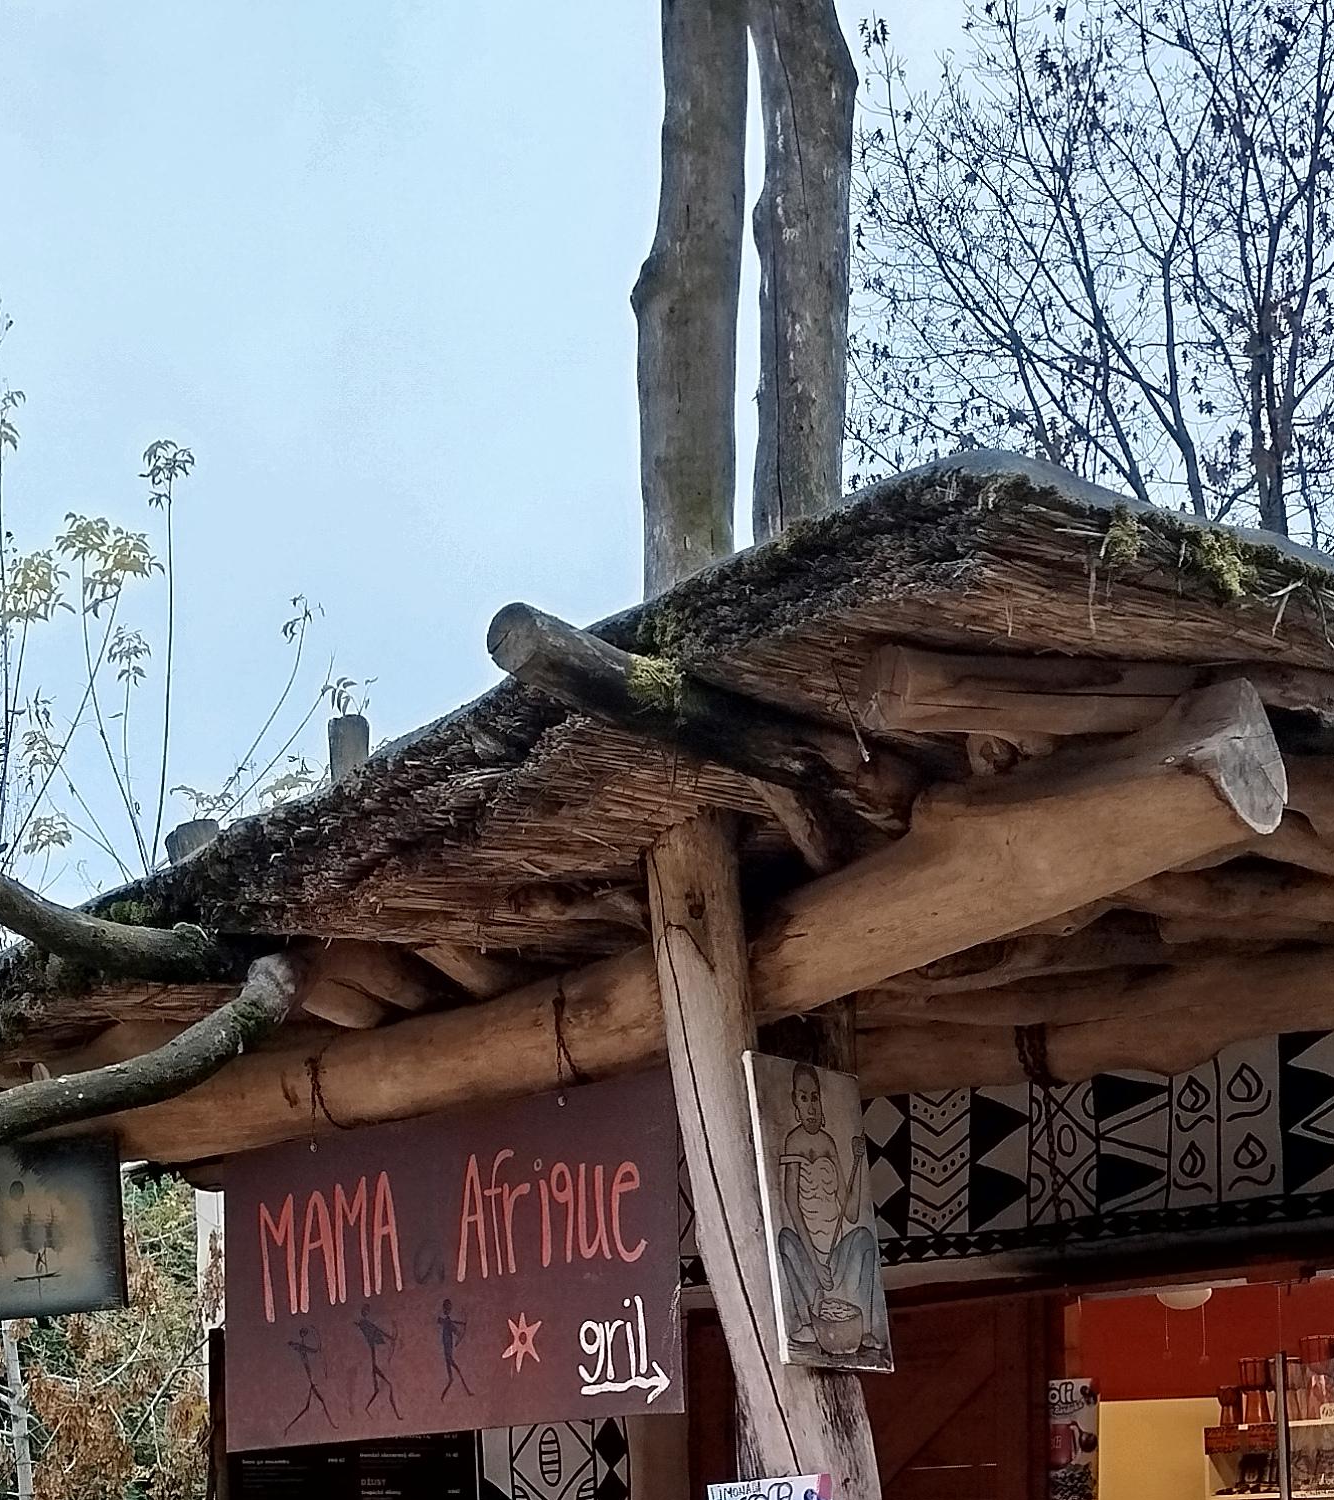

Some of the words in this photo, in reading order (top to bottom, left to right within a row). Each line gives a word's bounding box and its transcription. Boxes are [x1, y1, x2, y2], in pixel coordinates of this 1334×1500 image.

[258, 1171, 403, 1322] MAMA
[457, 1148, 649, 1282] Afrique
[578, 1295, 650, 1384] gril
